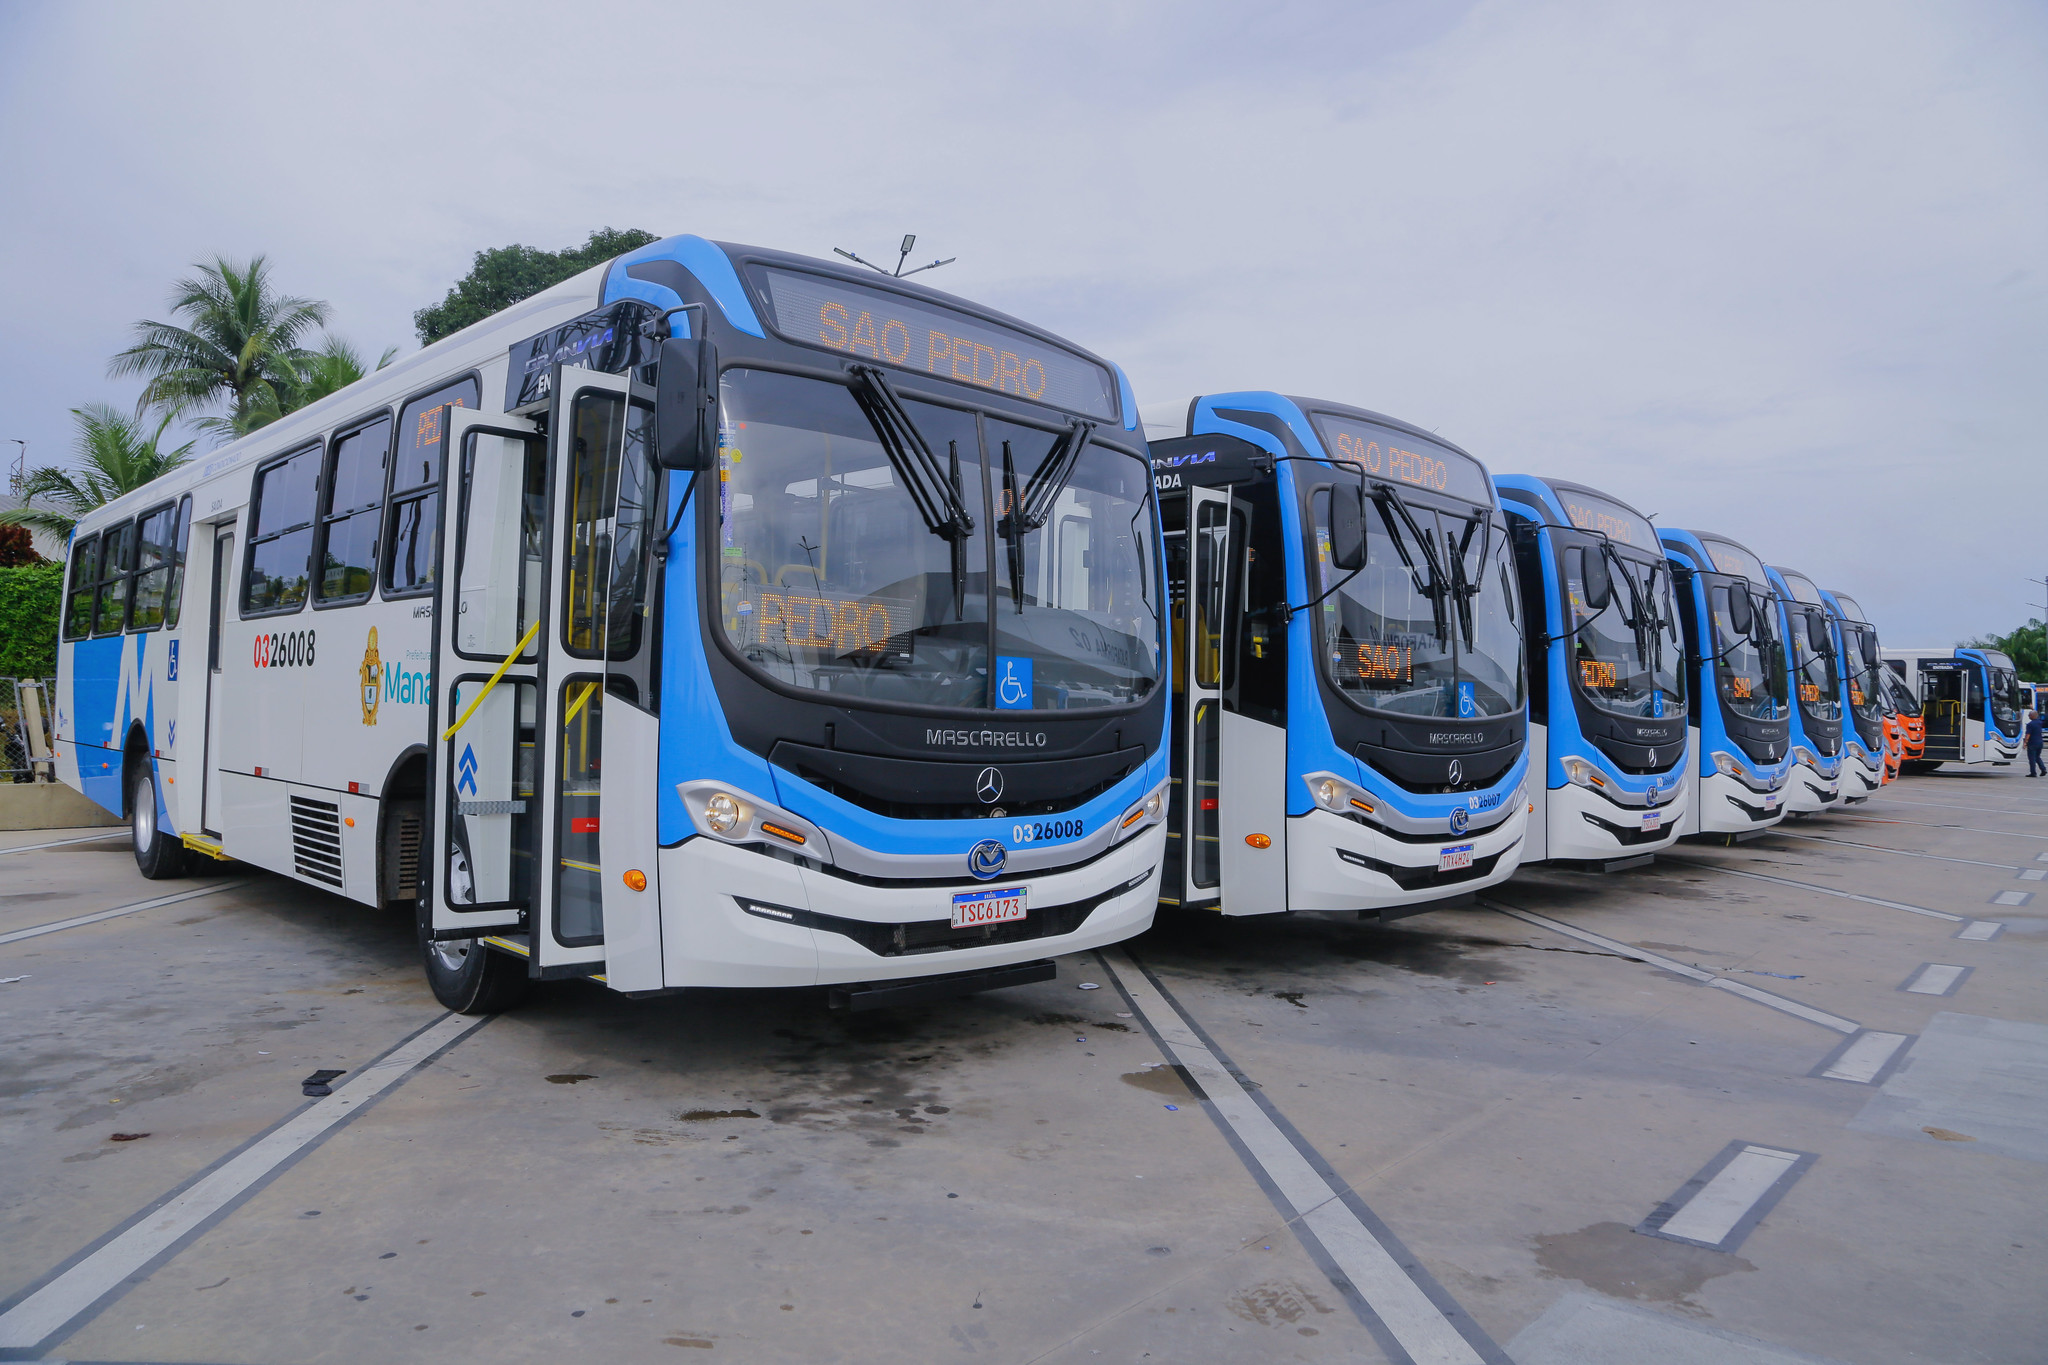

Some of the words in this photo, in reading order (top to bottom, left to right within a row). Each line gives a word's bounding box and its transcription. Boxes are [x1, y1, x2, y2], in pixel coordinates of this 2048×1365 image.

[819, 301, 909, 364] SAO
[928, 330, 1046, 399] PEDRO
[416, 398, 464, 448] PED
[1338, 433, 1381, 473] SAO
[1389, 447, 1446, 490] PEDRO
[758, 593, 892, 652] PEDRO
[254, 629, 315, 668] 0326008
[1358, 644, 1400, 679] SAO
[384, 661, 461, 706] Mana
[926, 728, 1047, 748] MASCARELLO
[1012, 819, 1083, 844] 0326008
